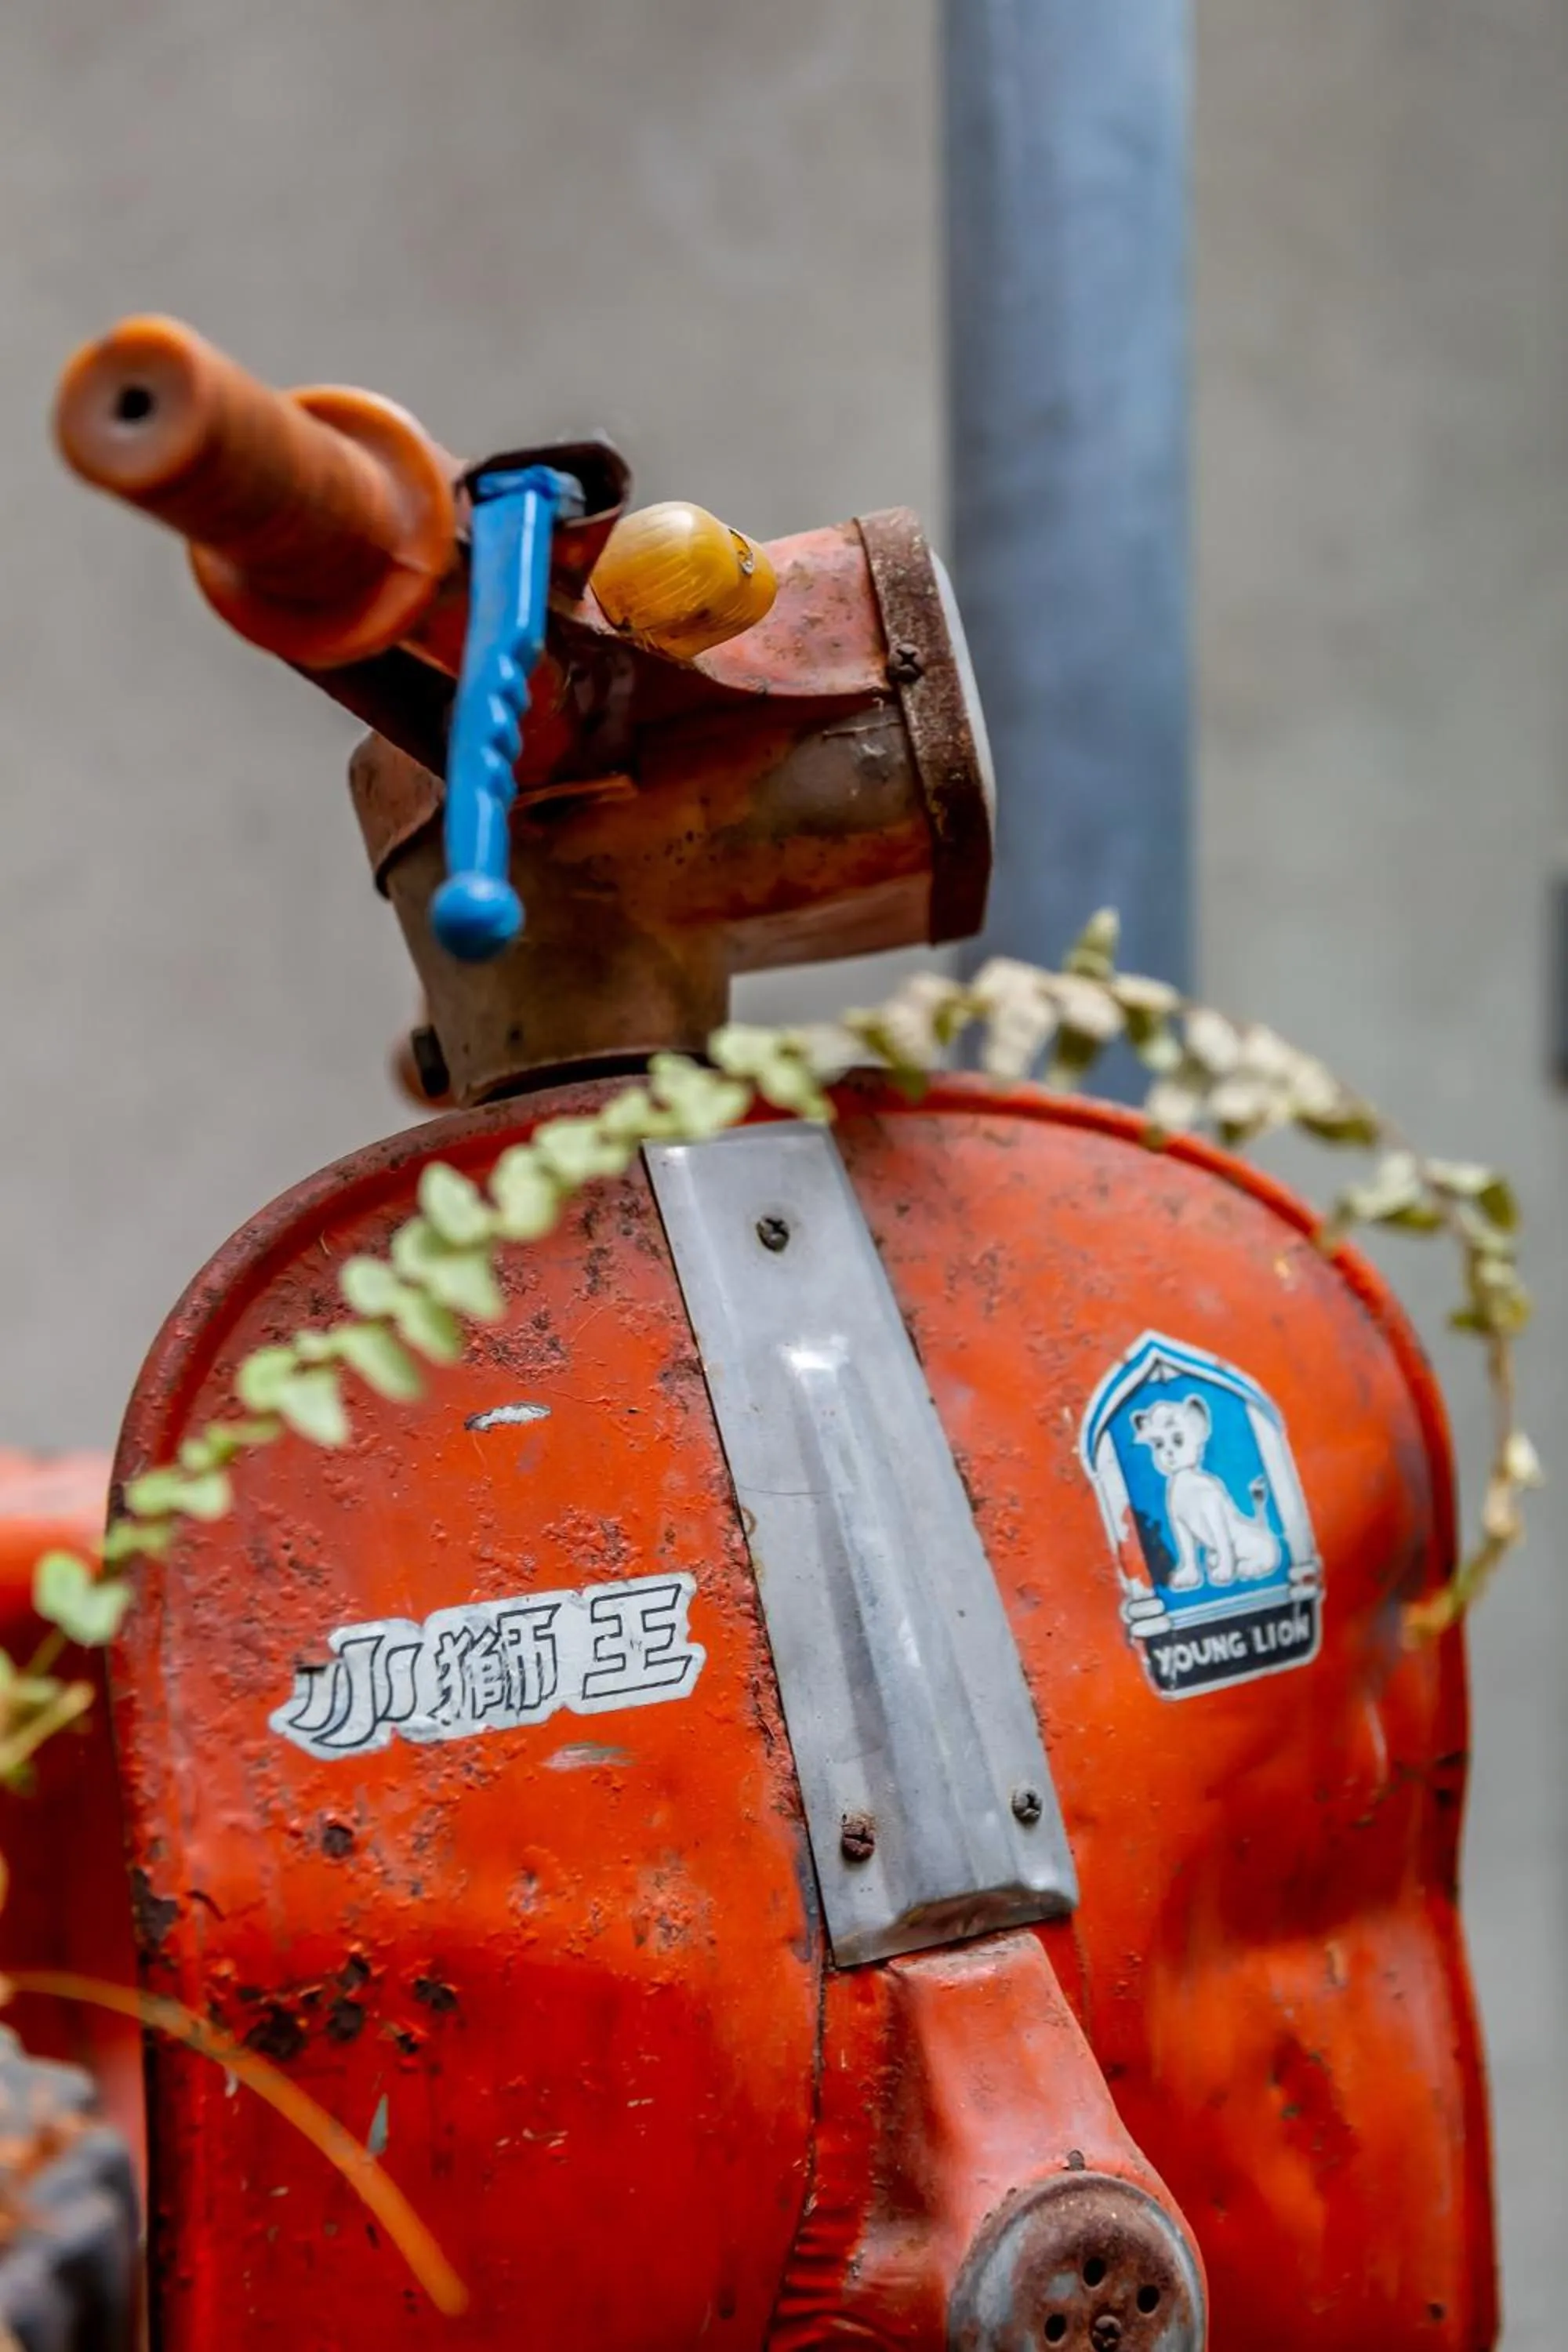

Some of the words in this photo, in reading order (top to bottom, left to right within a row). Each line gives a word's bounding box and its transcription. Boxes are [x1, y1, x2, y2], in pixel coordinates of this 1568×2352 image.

[288, 1584, 693, 1748] 小獅王
[1153, 1631, 1247, 1677] YOUNG
[1253, 1613, 1310, 1653] LION
